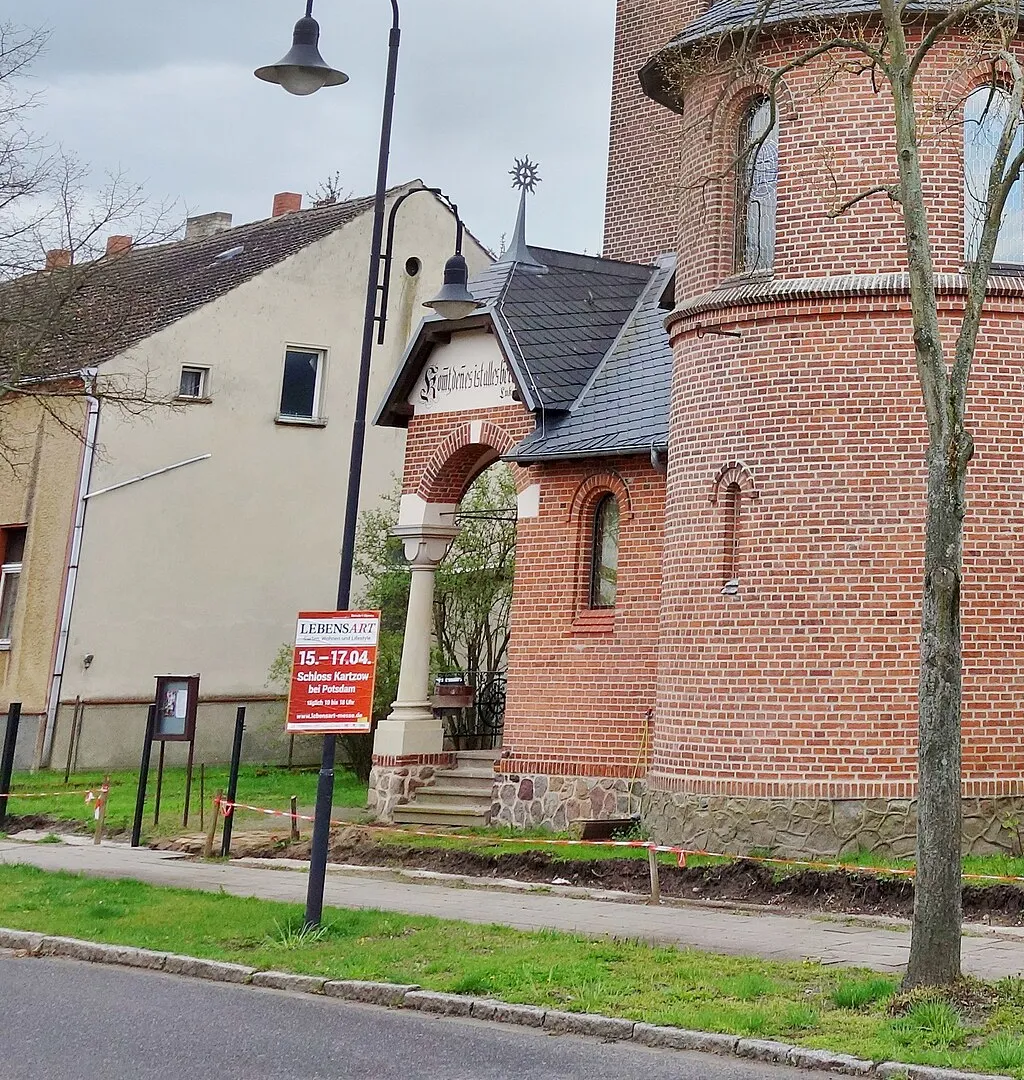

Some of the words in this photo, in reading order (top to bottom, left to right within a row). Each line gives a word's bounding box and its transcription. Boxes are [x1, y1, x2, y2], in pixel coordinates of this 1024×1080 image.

[300, 623, 376, 635] LEBENSART
[297, 671, 332, 682] Schloss
[333, 671, 369, 681] Kartzow
[308, 684, 321, 693] bei
[322, 684, 356, 693] Potsdam
